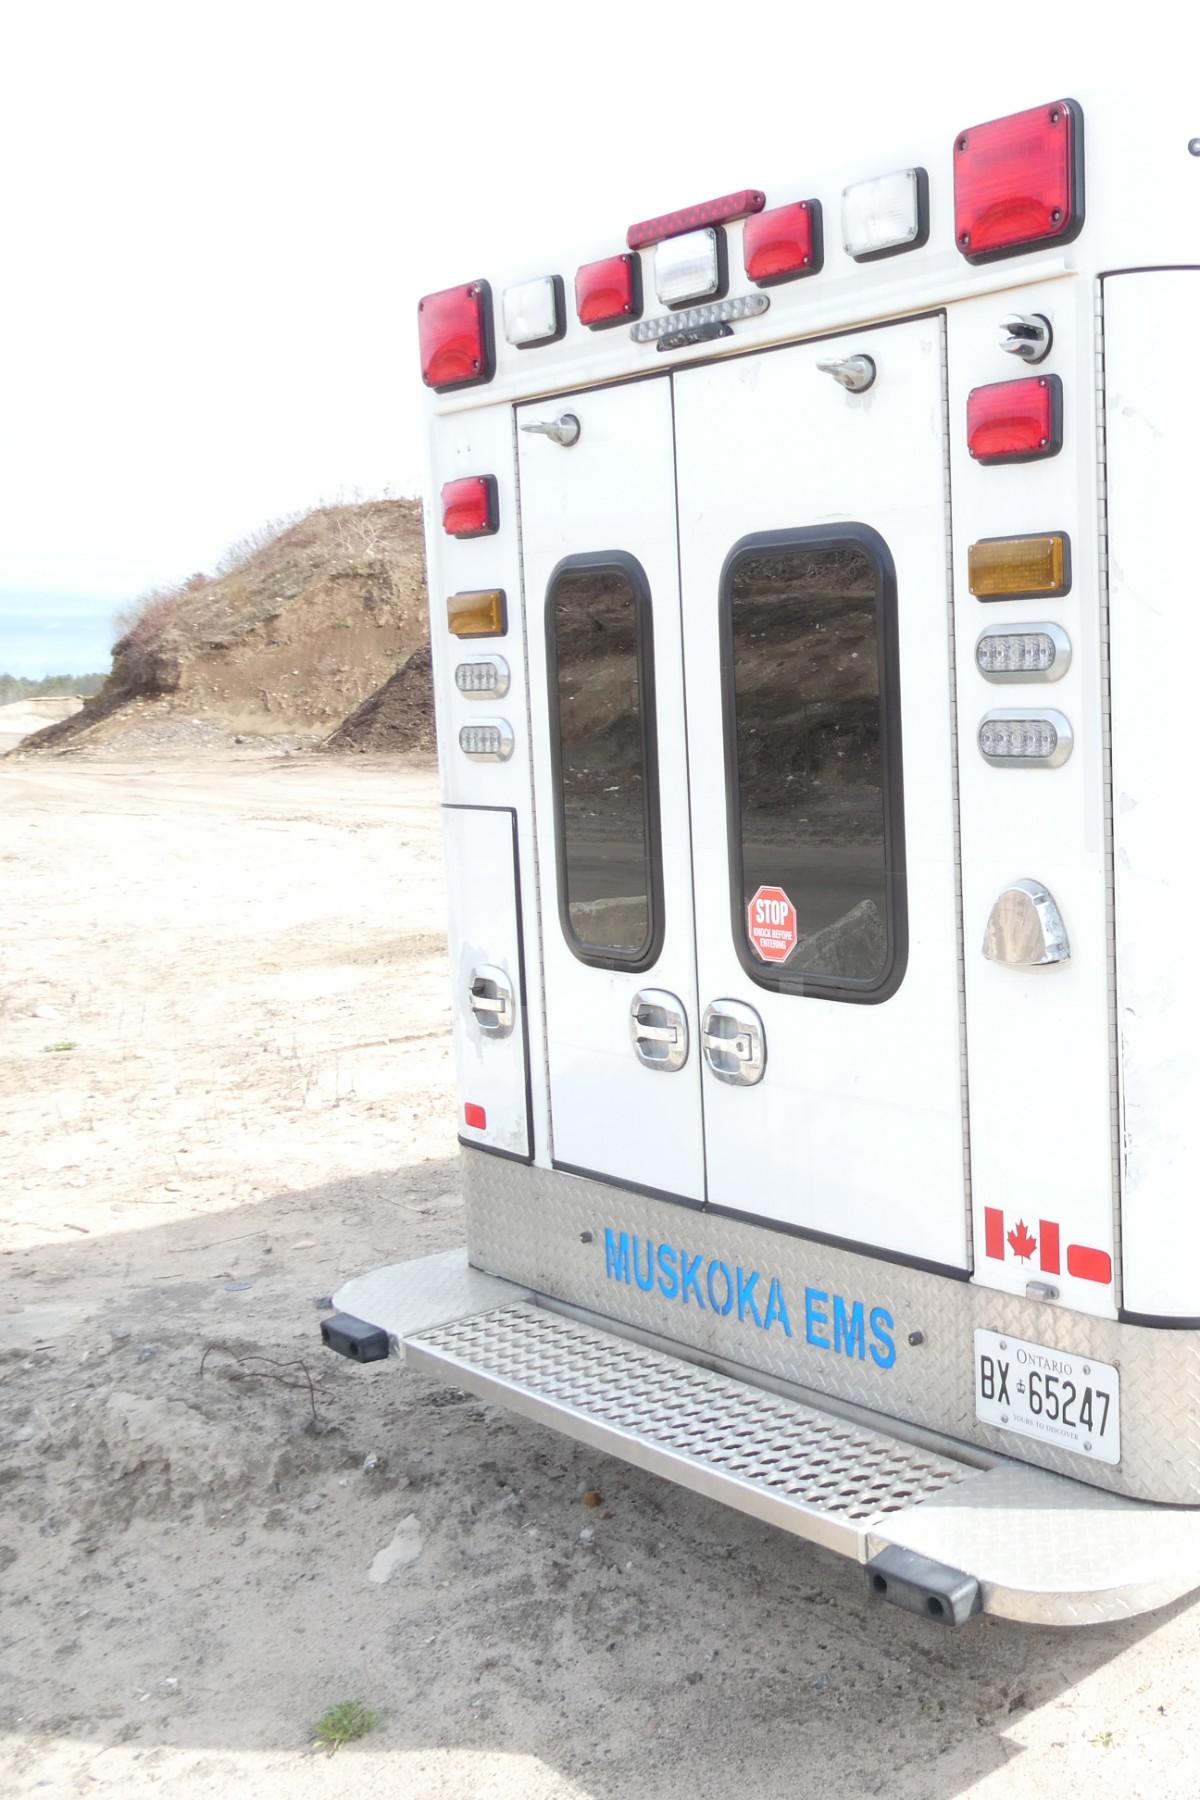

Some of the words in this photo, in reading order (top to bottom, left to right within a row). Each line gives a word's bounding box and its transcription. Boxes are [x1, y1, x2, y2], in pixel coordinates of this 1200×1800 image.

[756, 898, 788, 925] STOP
[772, 929, 793, 941] BEFORE
[604, 1227, 792, 1337] MUSKOKA
[805, 1287, 896, 1368] EMS
[1016, 1349, 1073, 1376] ONTARIO
[980, 1354, 1010, 1406] BX
[1028, 1371, 1110, 1437] 65247
